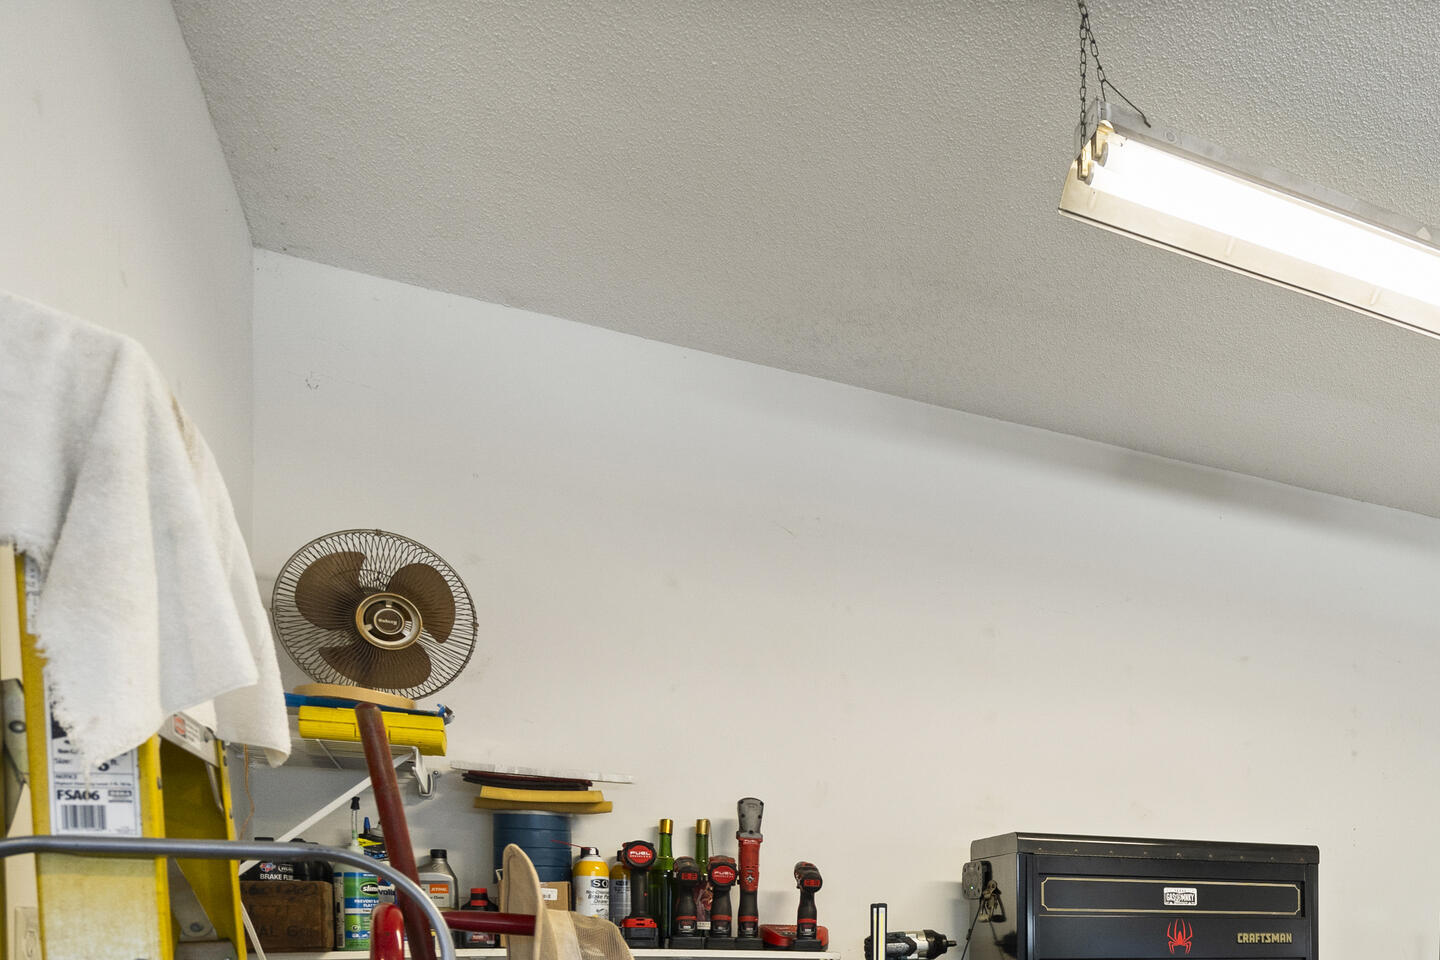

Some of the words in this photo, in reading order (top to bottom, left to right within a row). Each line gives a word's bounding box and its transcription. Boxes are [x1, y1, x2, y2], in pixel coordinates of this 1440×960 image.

[57, 789, 100, 801] FSA06
[259, 873, 283, 881] BRAKE
[1237, 933, 1292, 944] CRAFTSMAN
